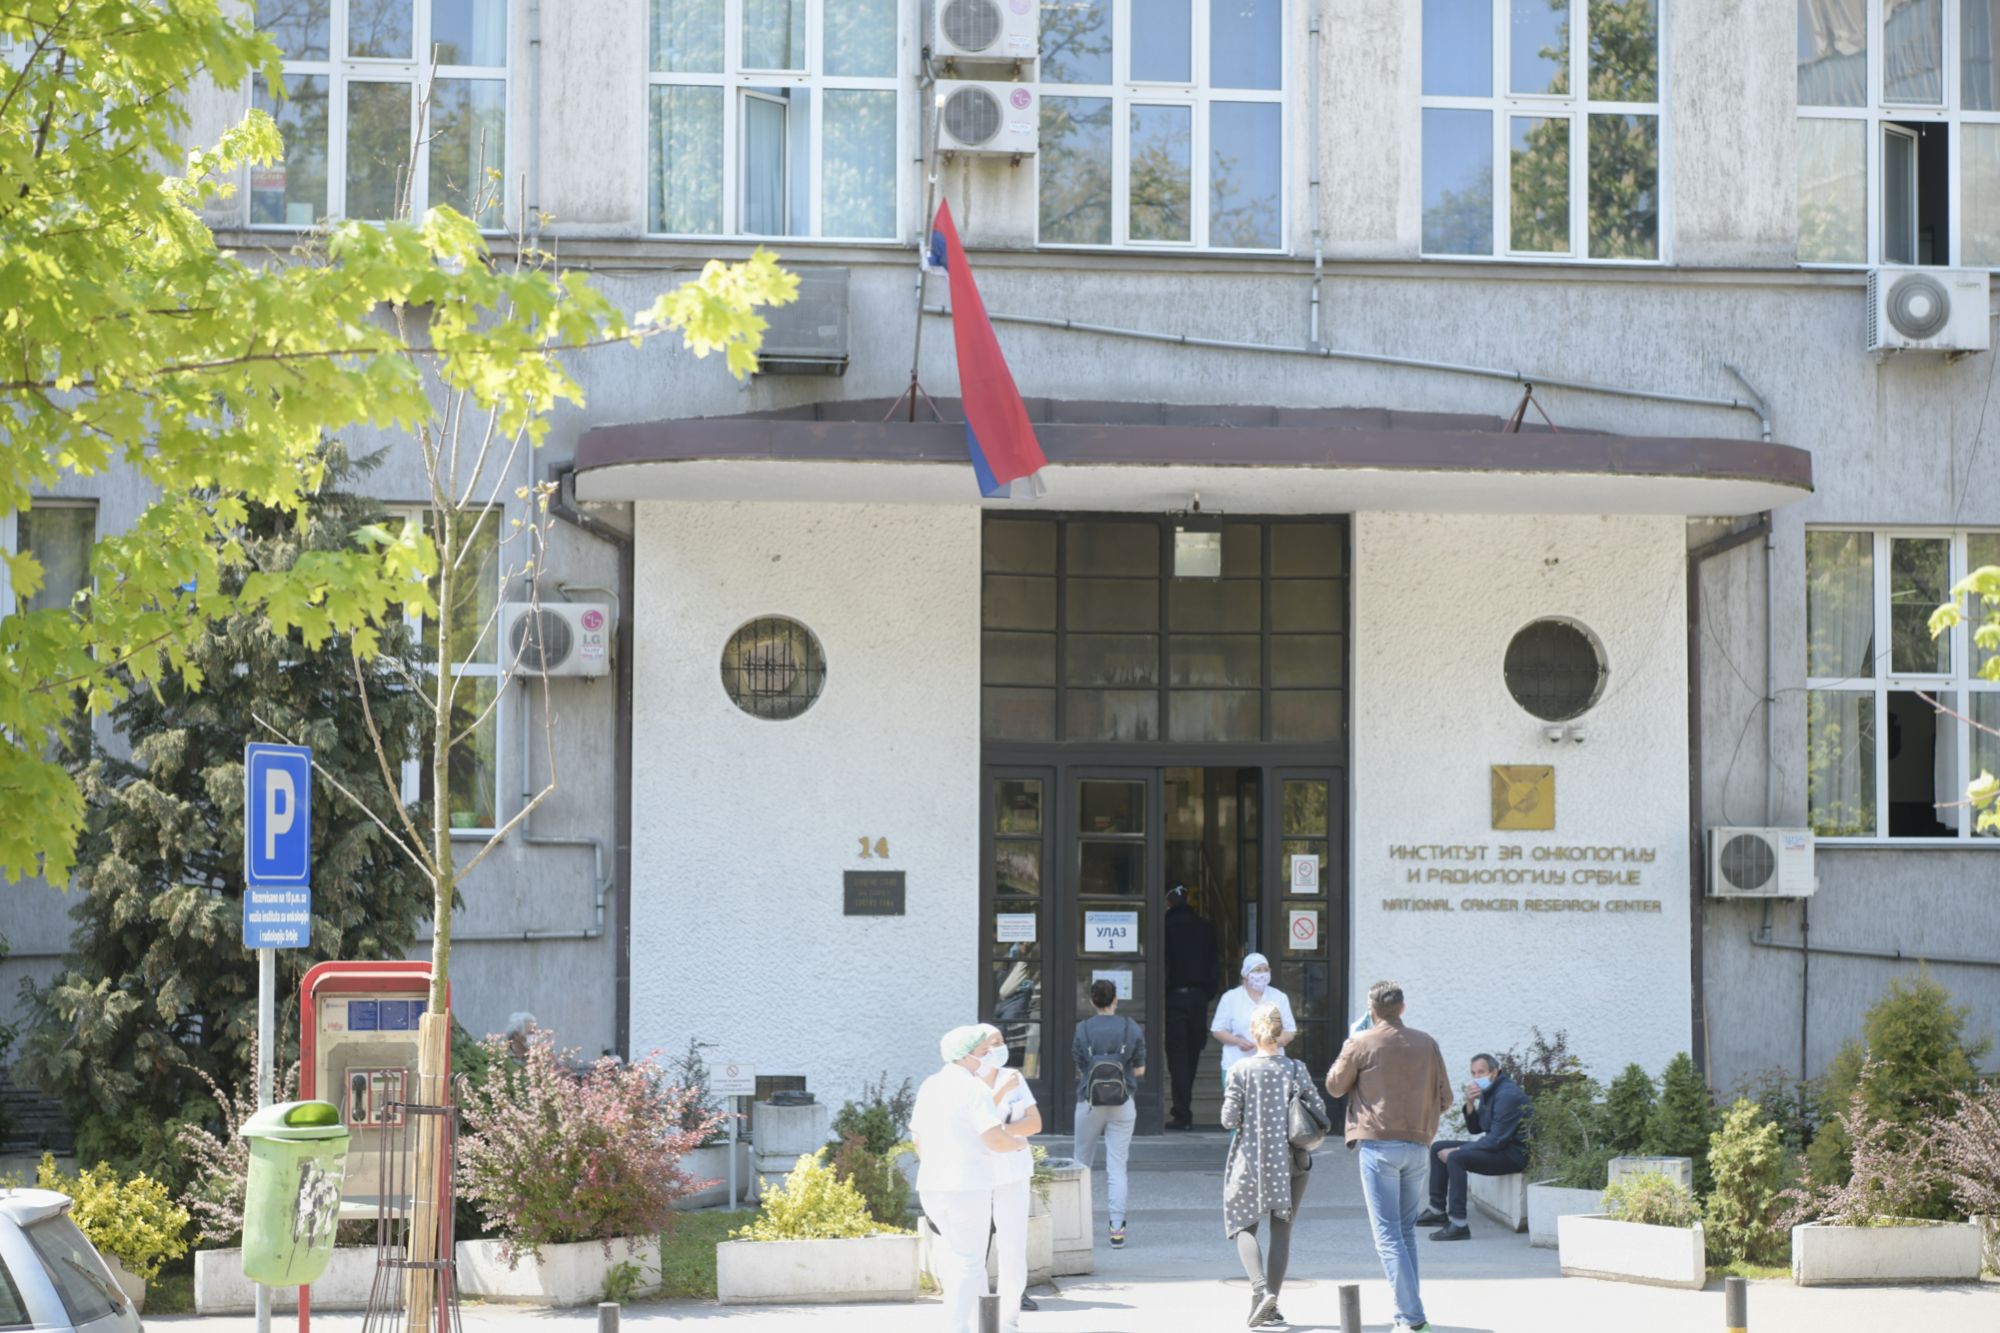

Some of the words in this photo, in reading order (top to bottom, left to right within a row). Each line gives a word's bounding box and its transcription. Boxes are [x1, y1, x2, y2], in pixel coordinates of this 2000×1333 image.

[583, 634, 601, 645] LG
[265, 768, 295, 860] P
[858, 836, 889, 858] 14
[1389, 844, 1488, 860] ИНСТИТУТ
[1498, 845, 1523, 860] ЗА
[1531, 846, 1656, 862] ОНКОЛОГИЈУ
[1407, 868, 1421, 883] И
[1427, 868, 1566, 885] РАДИОЛОГИЈУ
[1572, 869, 1641, 885] СРБИЈЕ
[1382, 898, 1454, 912] NATIONAL
[1460, 898, 1519, 912] CANCER
[1524, 899, 1600, 912] RESEARCH
[1604, 900, 1662, 913] CENTER
[1096, 927, 1127, 938] УЛАЗ
[1108, 938, 1115, 949] 1
